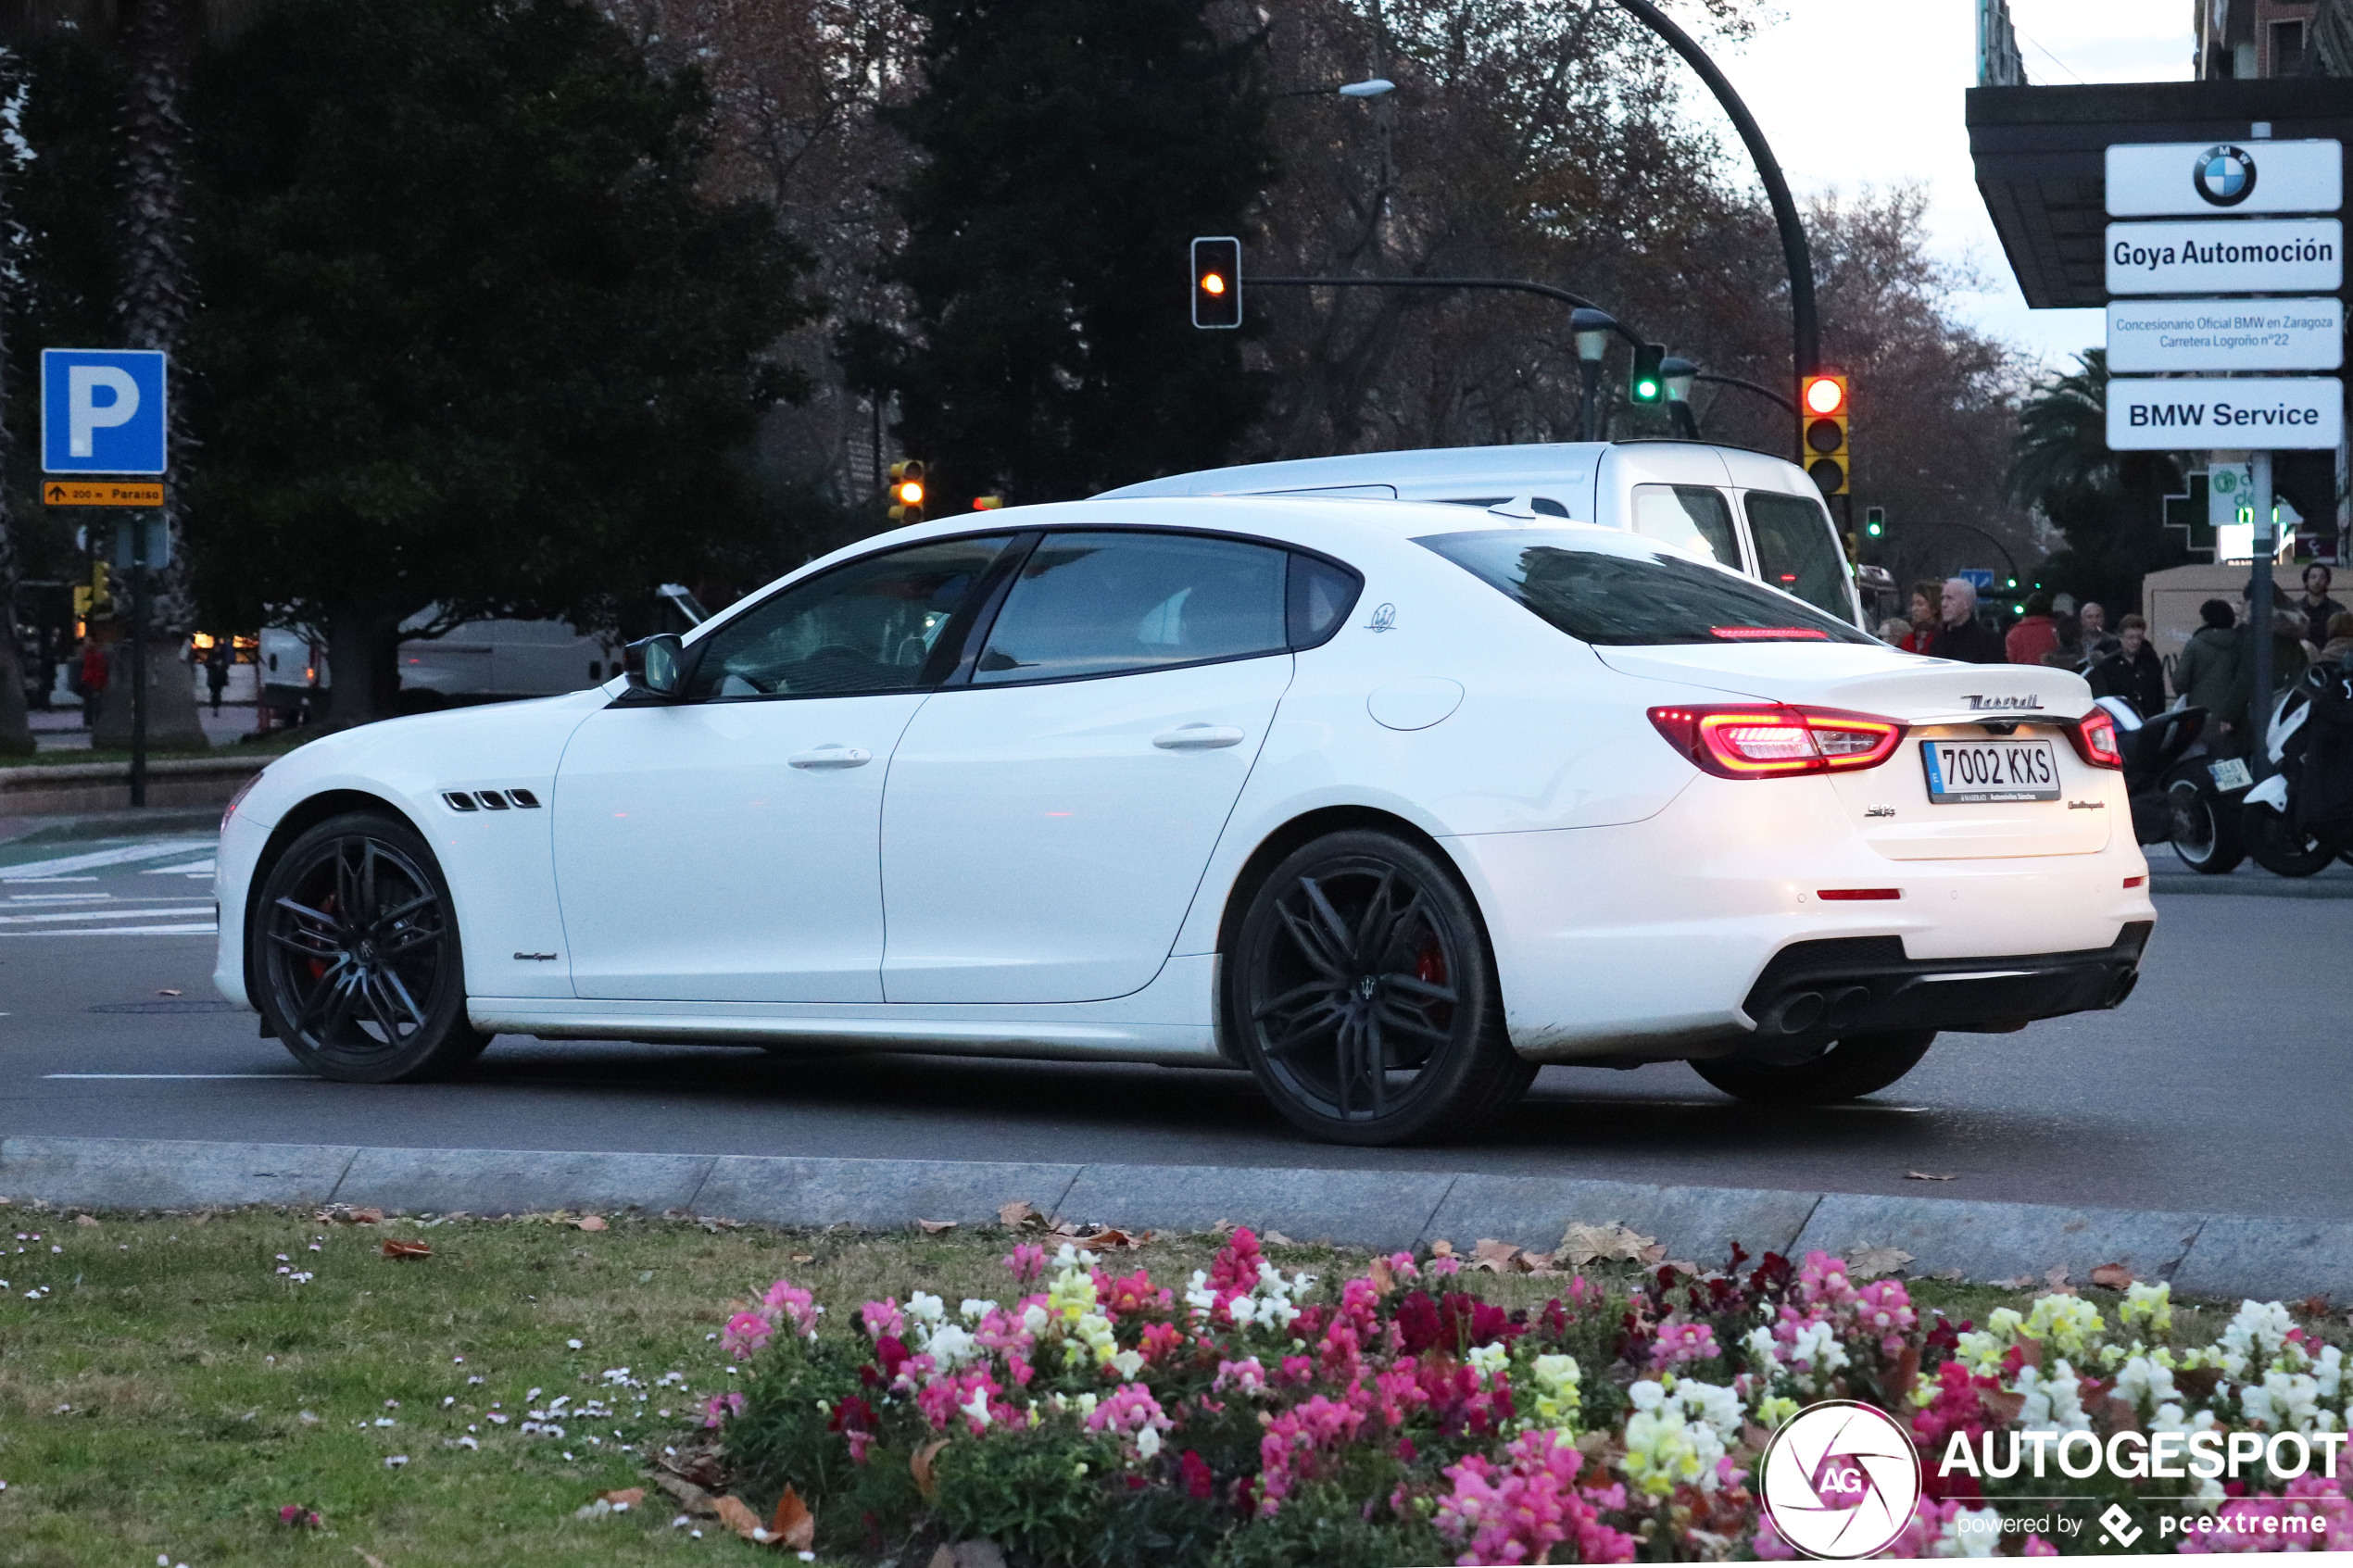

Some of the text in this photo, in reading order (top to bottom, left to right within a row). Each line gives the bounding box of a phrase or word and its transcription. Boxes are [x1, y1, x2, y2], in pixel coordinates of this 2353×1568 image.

[2199, 145, 2251, 165] BMW
[2113, 237, 2333, 270] Goya Automoción
[2116, 316, 2334, 332] Concesionario Oficial BMW en Zaragoza
[2159, 334, 2211, 348] Carretera
[2213, 333, 2259, 349] Logroño
[69, 366, 140, 457] P
[2129, 402, 2320, 427] BMW Service
[72, 489, 92, 499] 200
[1960, 694, 2045, 710] Maserati
[1942, 748, 2004, 785] 7002
[2006, 748, 2051, 784] KXS
